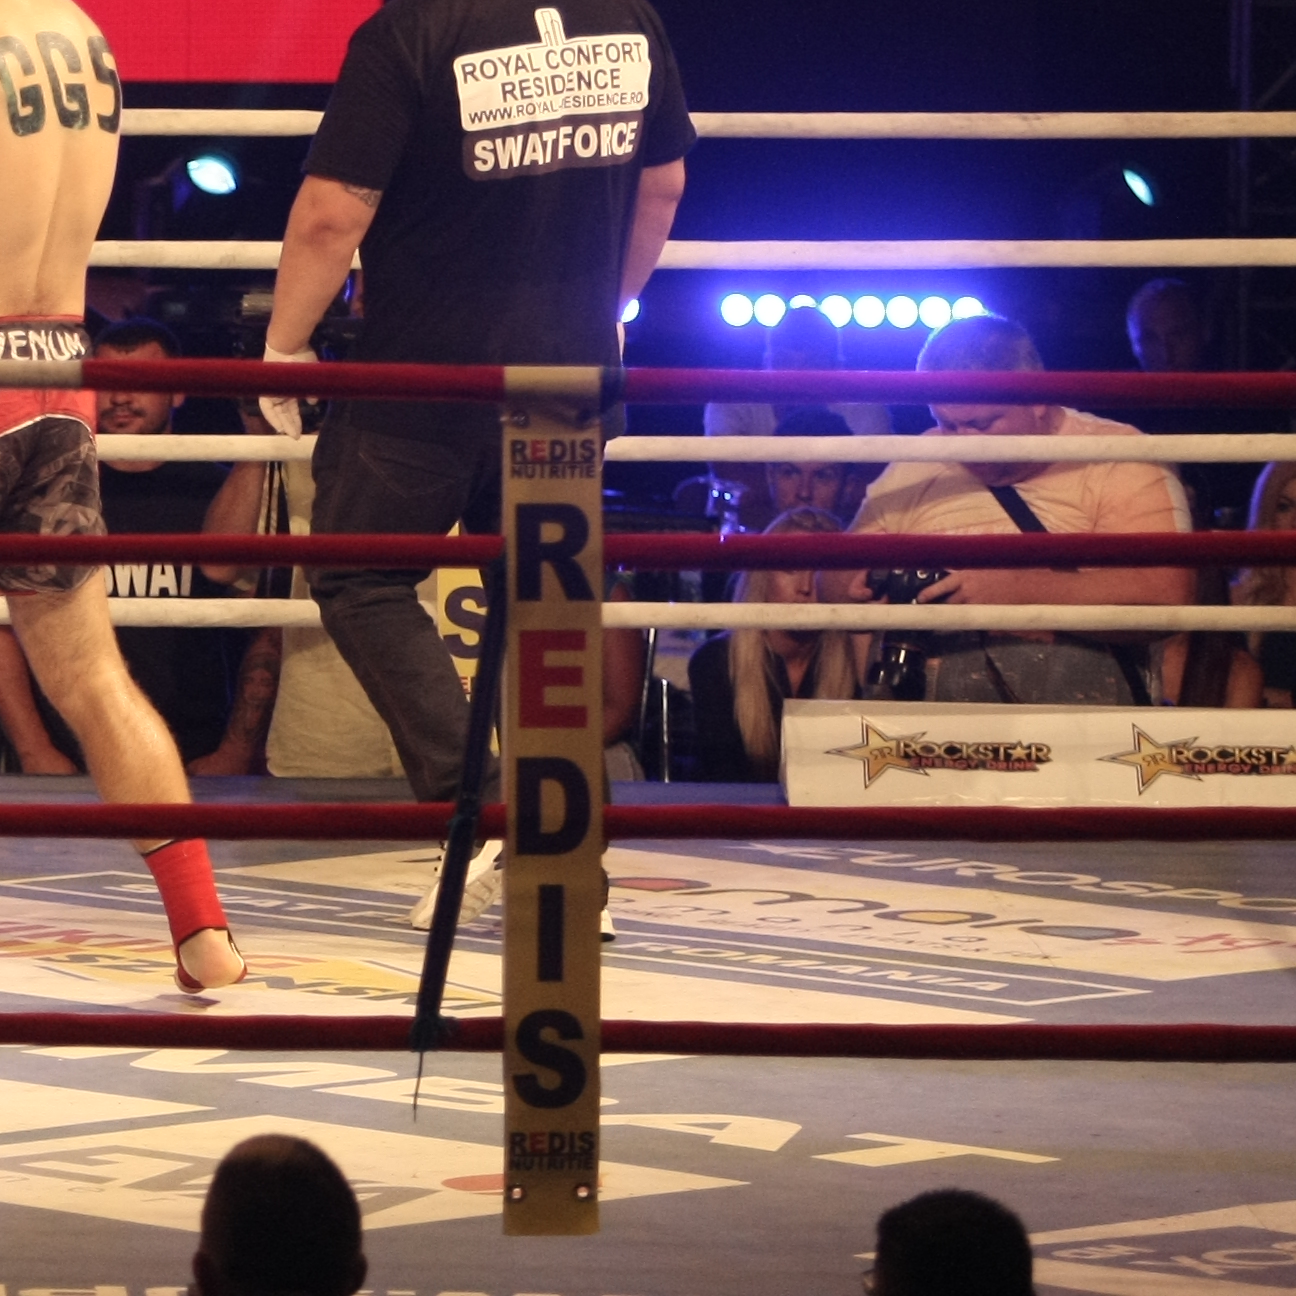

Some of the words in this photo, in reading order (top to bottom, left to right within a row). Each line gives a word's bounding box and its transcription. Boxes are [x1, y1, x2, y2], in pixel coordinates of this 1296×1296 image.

[461, 51, 541, 84] ROYAL
[545, 42, 643, 70] CONFORT
[501, 68, 621, 103] RESIDENCE
[474, 121, 638, 171] SWATFORCE
[510, 439, 596, 462] REDIS
[510, 463, 596, 480] NUTRITIE
[899, 738, 1053, 765] ROCKSTAR
[512, 503, 591, 1109] REDIS
[609, 942, 1009, 992] ROMANIA
[509, 1131, 595, 1155] REDIS
[509, 1155, 595, 1172] NUTRITIE
